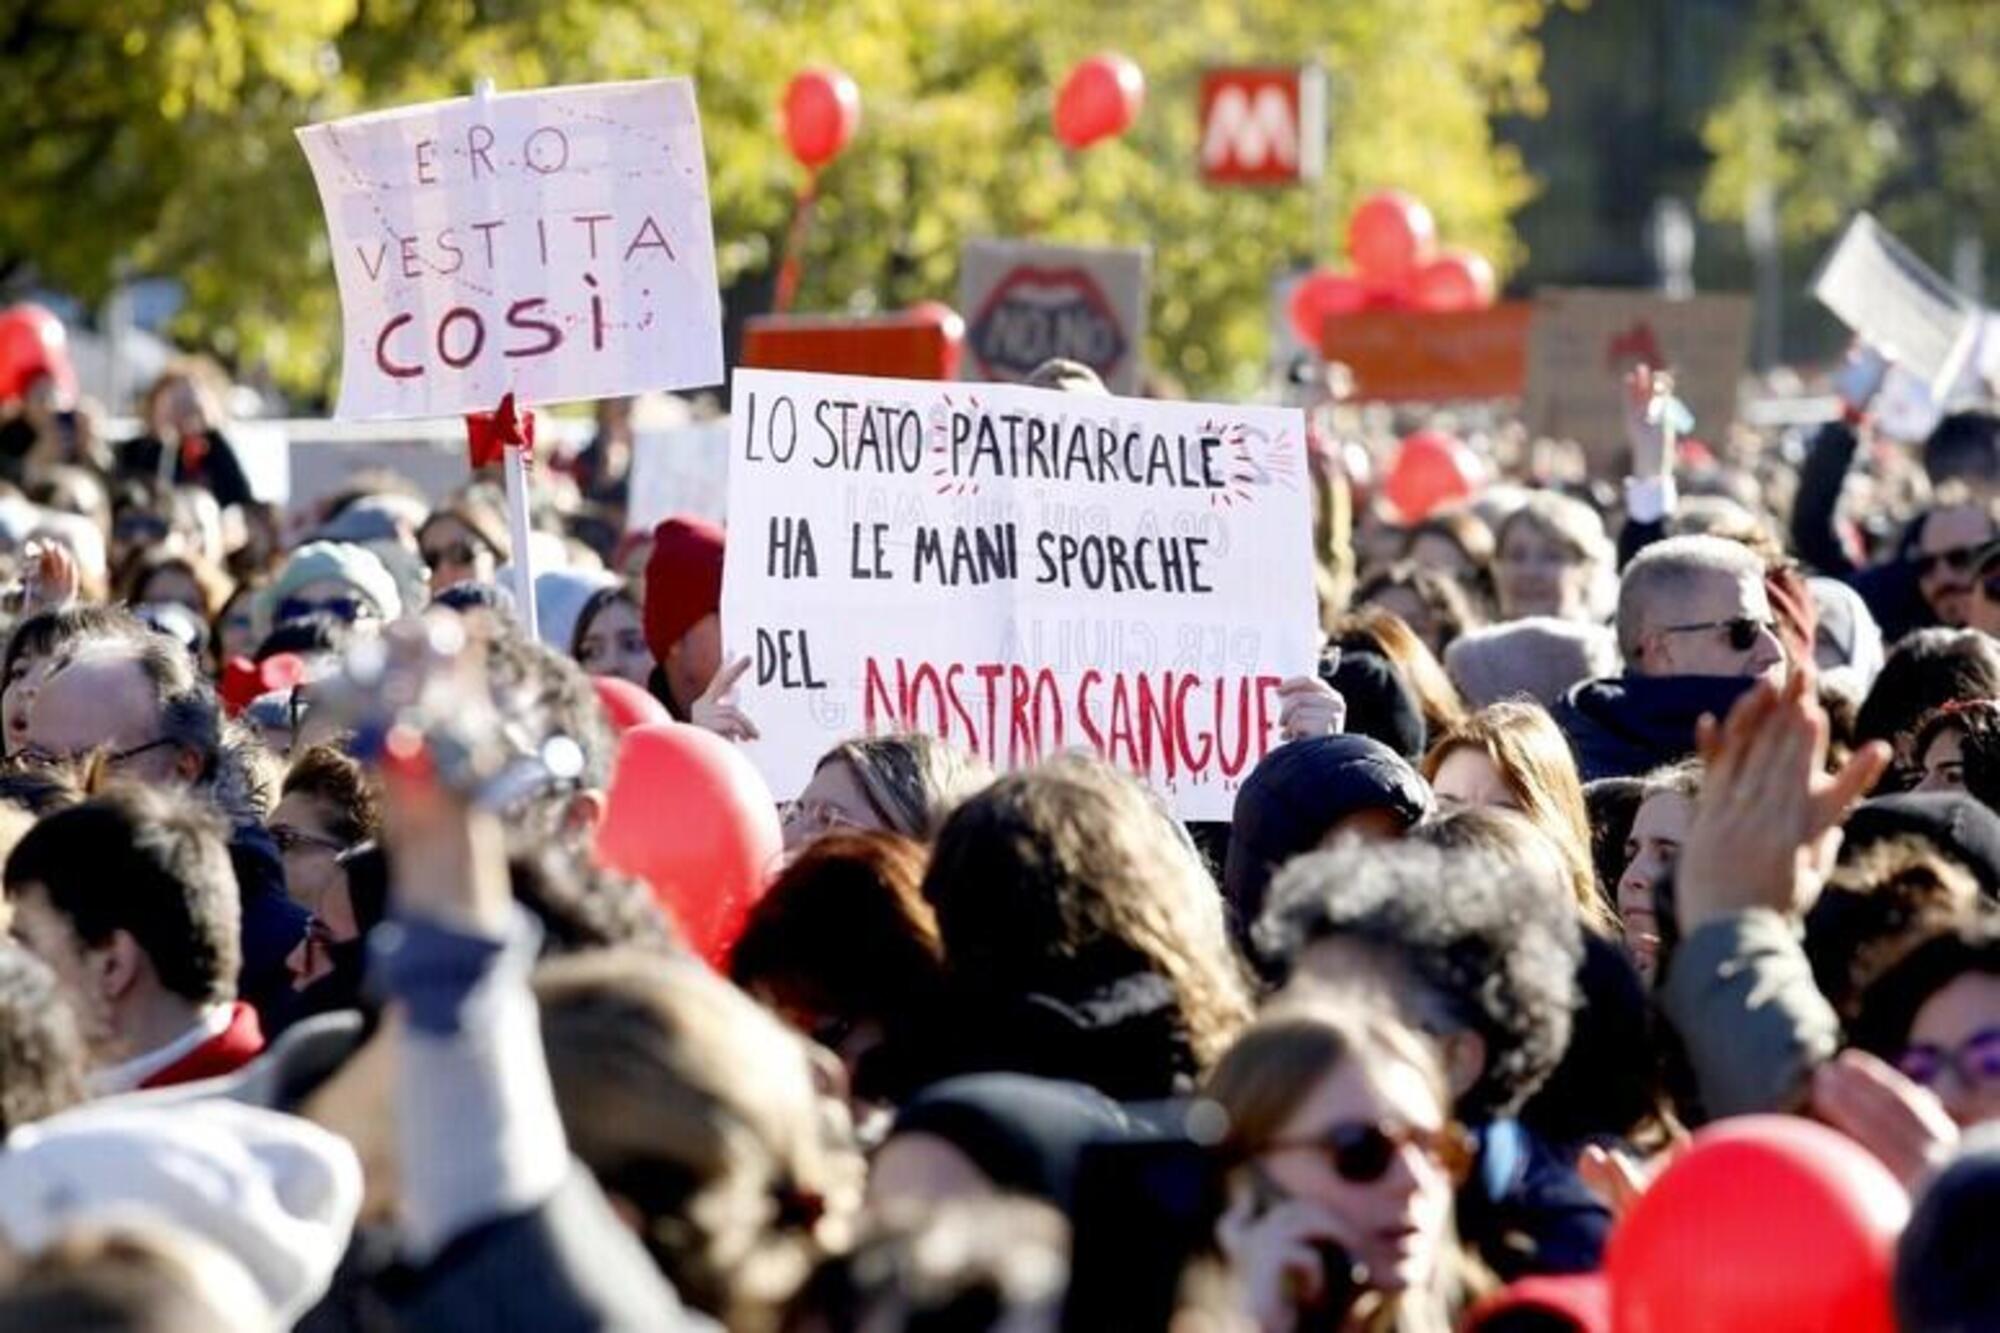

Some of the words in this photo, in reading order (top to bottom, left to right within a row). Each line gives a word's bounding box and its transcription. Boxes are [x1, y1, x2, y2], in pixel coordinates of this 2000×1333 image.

[416, 125, 569, 184] ERO
[1202, 82, 1299, 168] M
[357, 215, 676, 280] VESTITA
[376, 273, 604, 378] COSÌ
[745, 392, 797, 463] LO
[813, 399, 923, 473] STATO
[951, 412, 1227, 489] PATRIARCALE
[768, 516, 818, 579] HA
[850, 522, 893, 580] LE
[913, 523, 1017, 586] MANI
[1036, 530, 1213, 593] SPORCHE
[757, 628, 827, 690] DEL
[865, 656, 1065, 768] NOSTRO
[1077, 669, 1283, 782] SANGUE
